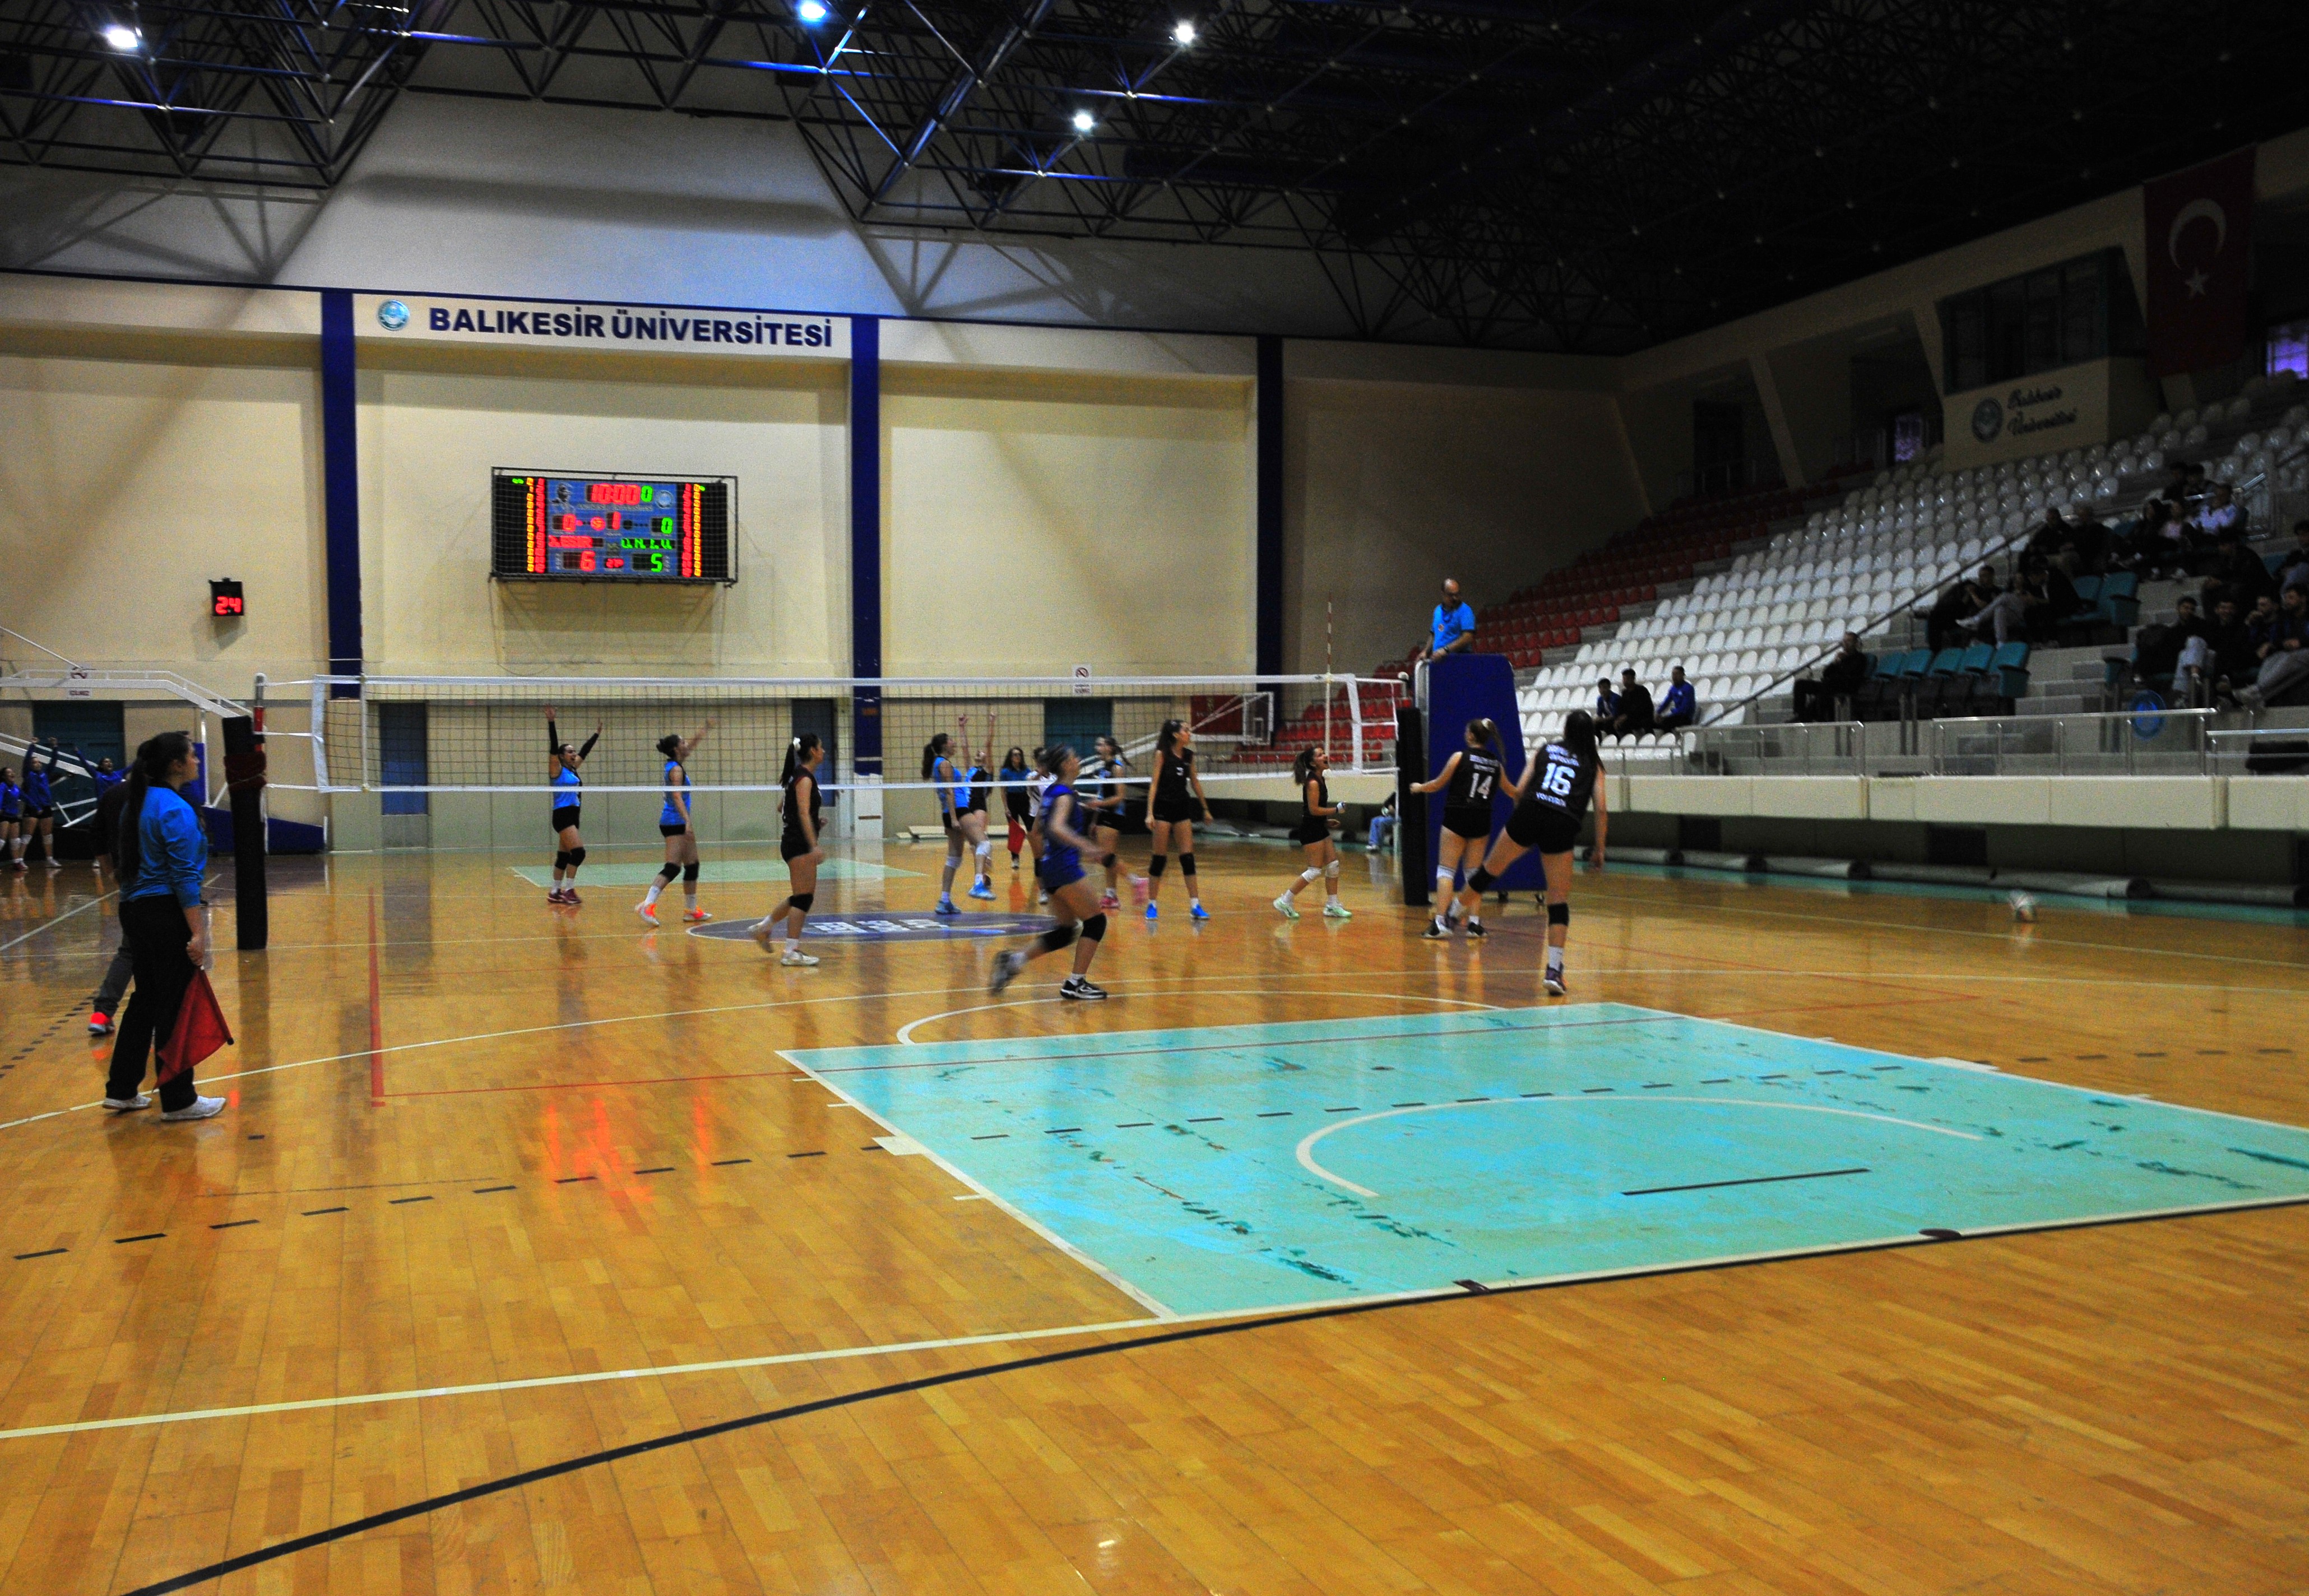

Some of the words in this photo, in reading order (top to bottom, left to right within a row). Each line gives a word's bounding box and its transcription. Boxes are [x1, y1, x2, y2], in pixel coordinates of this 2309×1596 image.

[429, 307, 606, 338] BALIKESİR
[612, 308, 832, 347] ÜNİVERSİTESİ
[579, 550, 596, 572] 6
[651, 553, 663, 572] 5
[215, 596, 243, 615] 24
[1469, 772, 1493, 799] 14
[1542, 763, 1576, 796] 16
